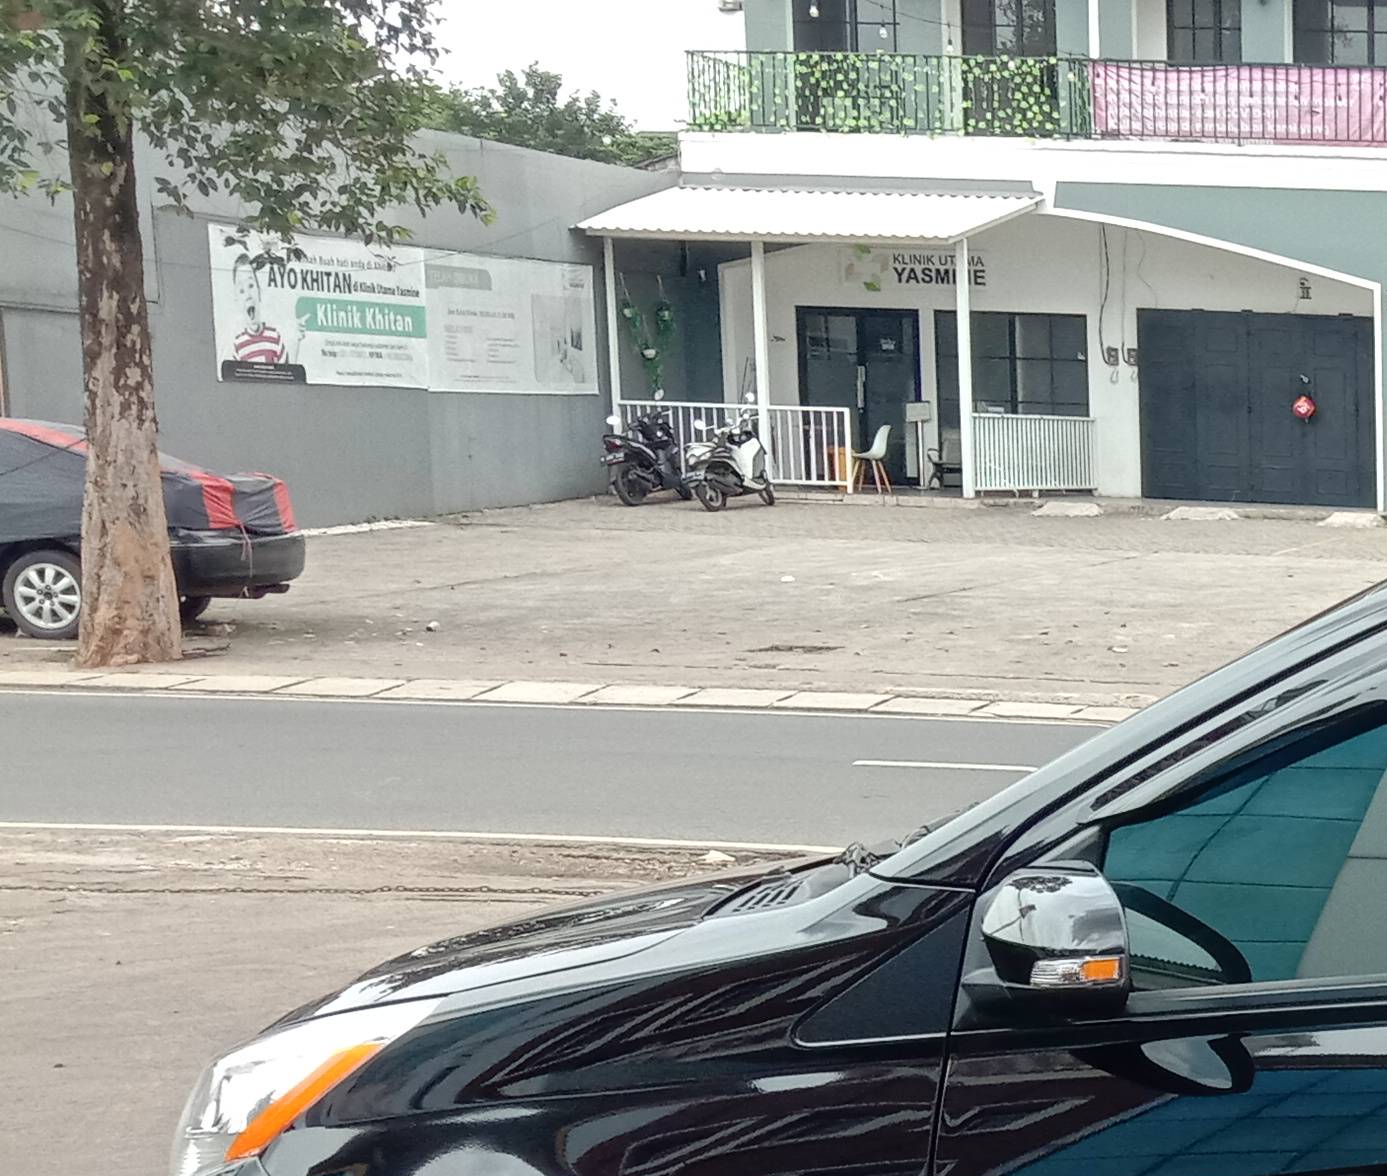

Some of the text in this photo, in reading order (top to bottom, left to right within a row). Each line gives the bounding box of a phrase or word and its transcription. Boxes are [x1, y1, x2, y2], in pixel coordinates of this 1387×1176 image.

[893, 253, 985, 267] KLINIK UTMA
[267, 265, 298, 290] AYO
[301, 268, 352, 295] KHITAN
[316, 303, 413, 332] Klinik Khitan
